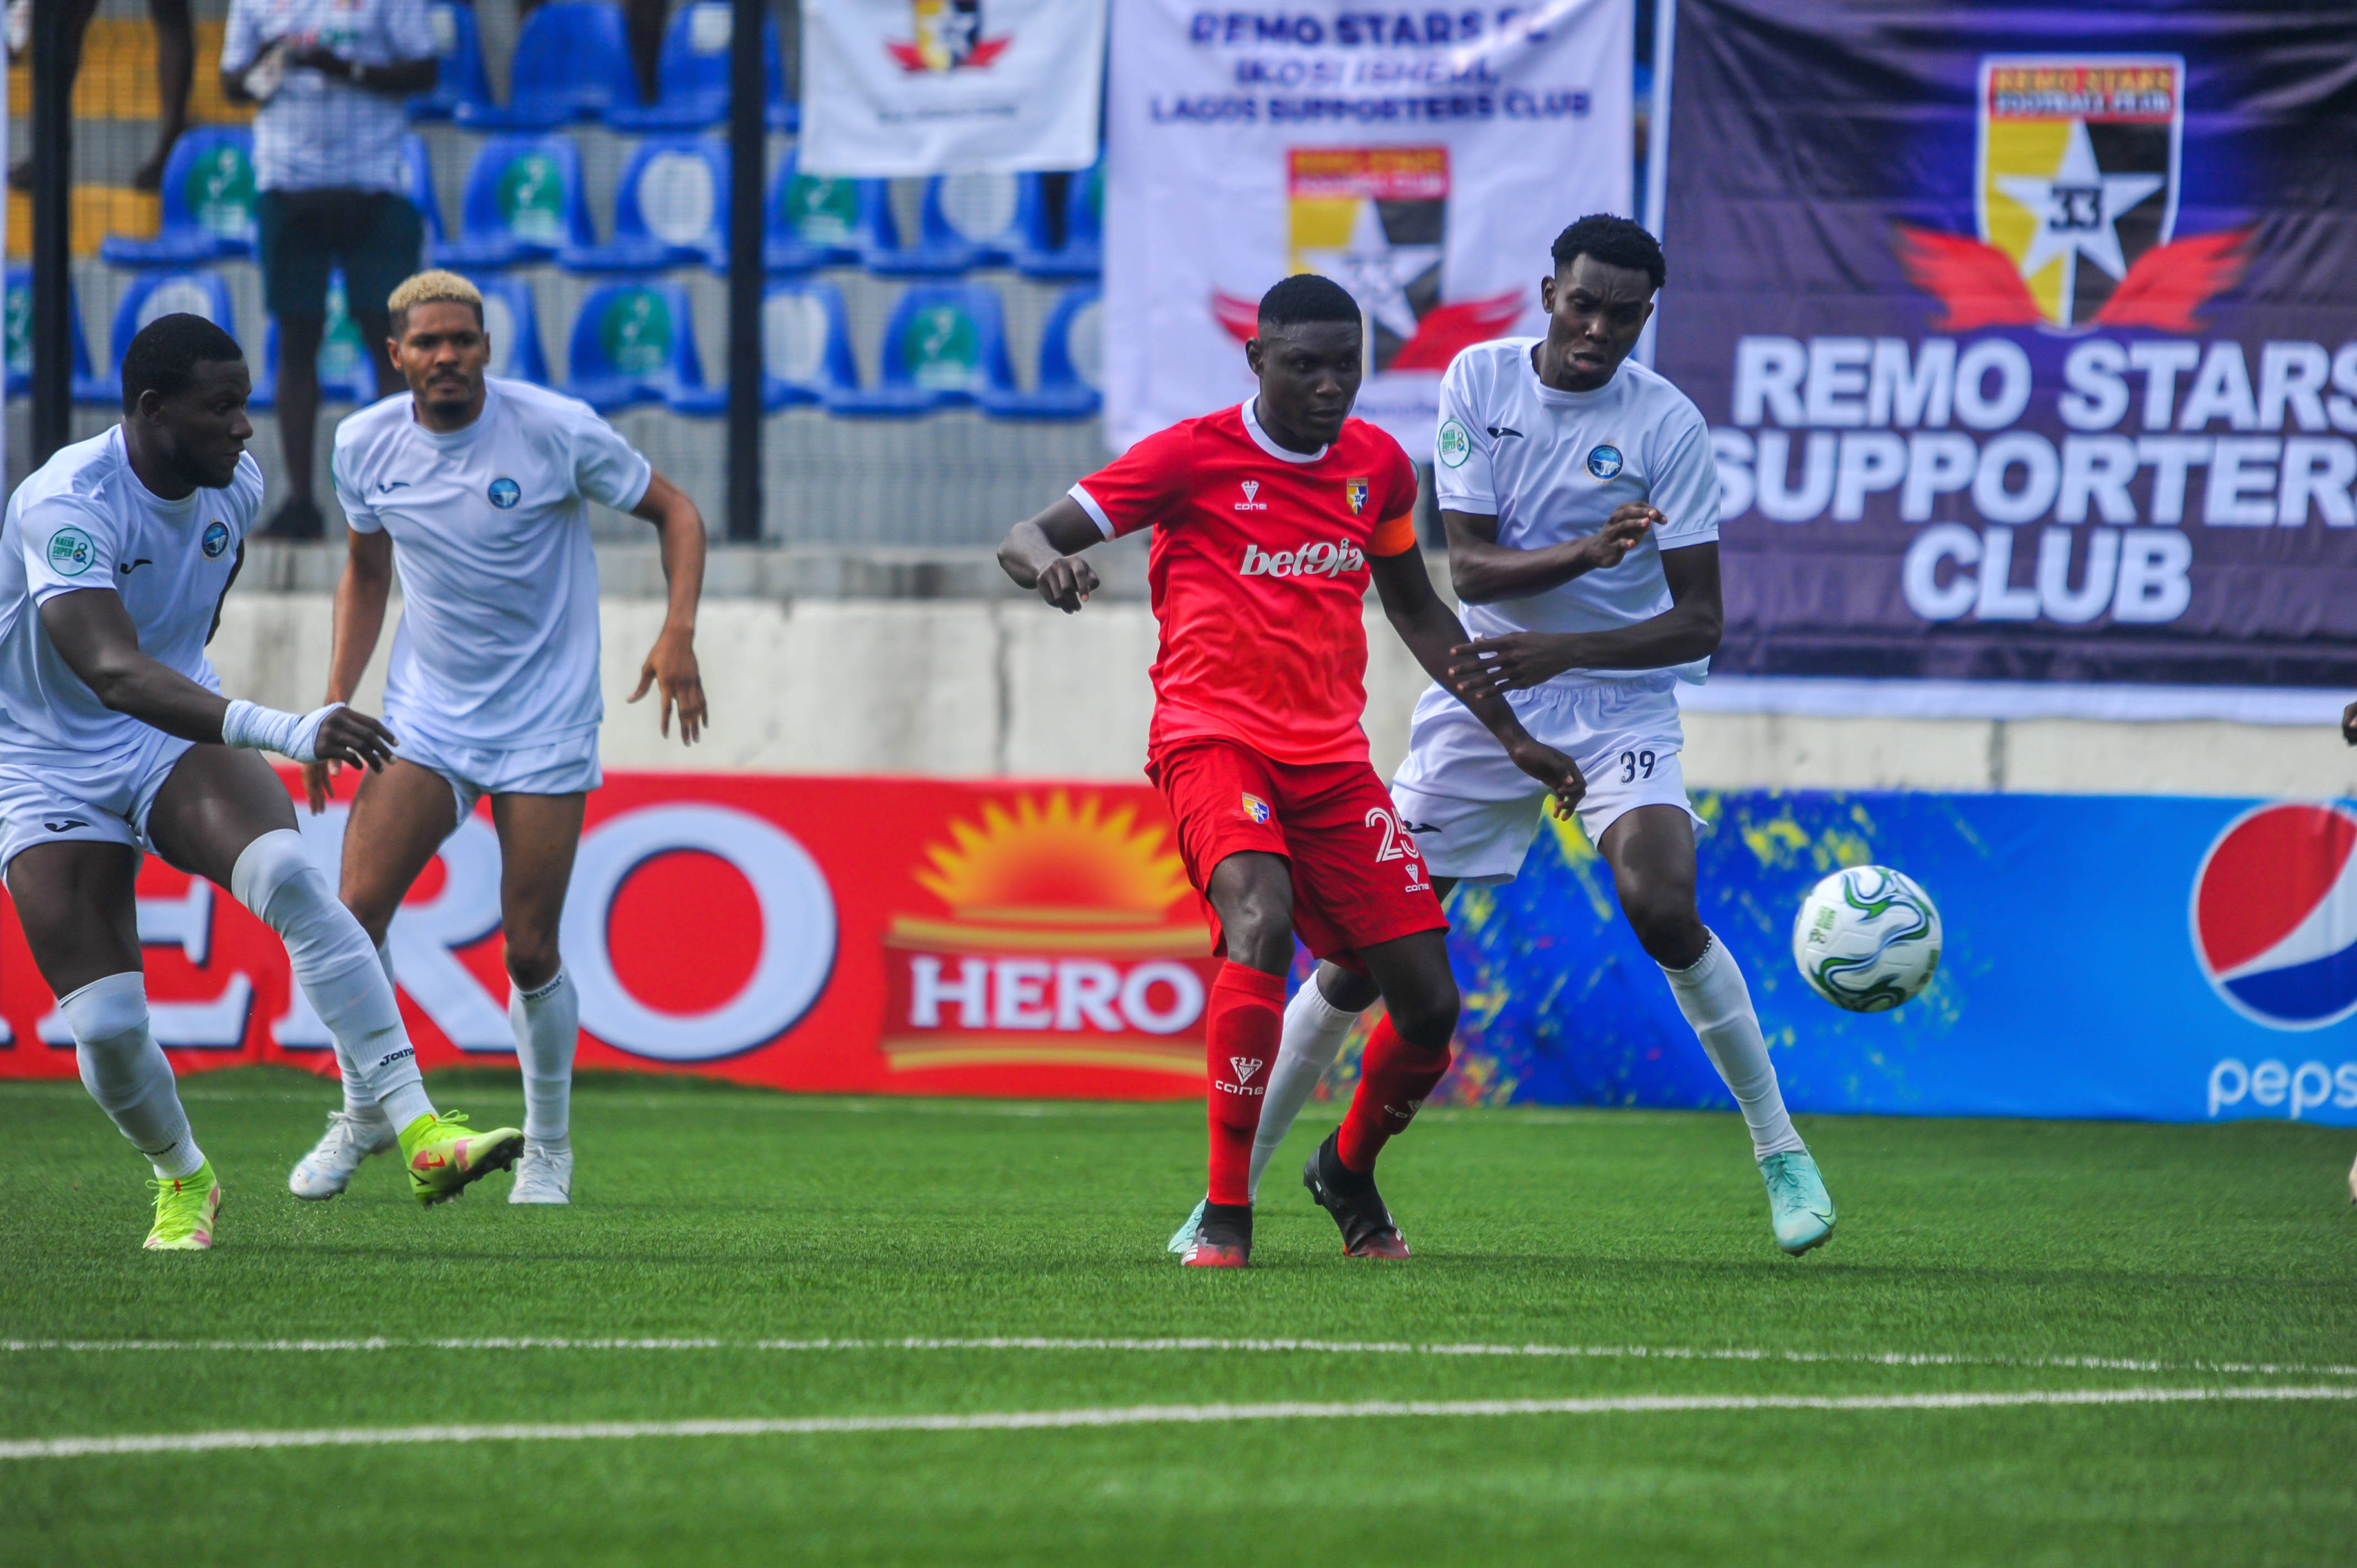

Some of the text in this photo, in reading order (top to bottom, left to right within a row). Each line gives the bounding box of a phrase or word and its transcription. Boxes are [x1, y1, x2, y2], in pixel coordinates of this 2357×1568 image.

[1188, 12, 1324, 45] REMO
[1335, 11, 1483, 46] STARS
[1150, 91, 1592, 126] LAGOS SUPPORTERS CLUB
[2050, 187, 2103, 230] 33
[1733, 335, 2032, 430] REMO
[1239, 538, 1365, 578] bet9ja
[1903, 522, 2193, 624] CLUB
[1620, 750, 1656, 785] 39
[1365, 807, 1419, 863] 25
[0, 802, 836, 1060] ERO
[908, 955, 1205, 1035] HERO
[1215, 1080, 1264, 1096] cone
